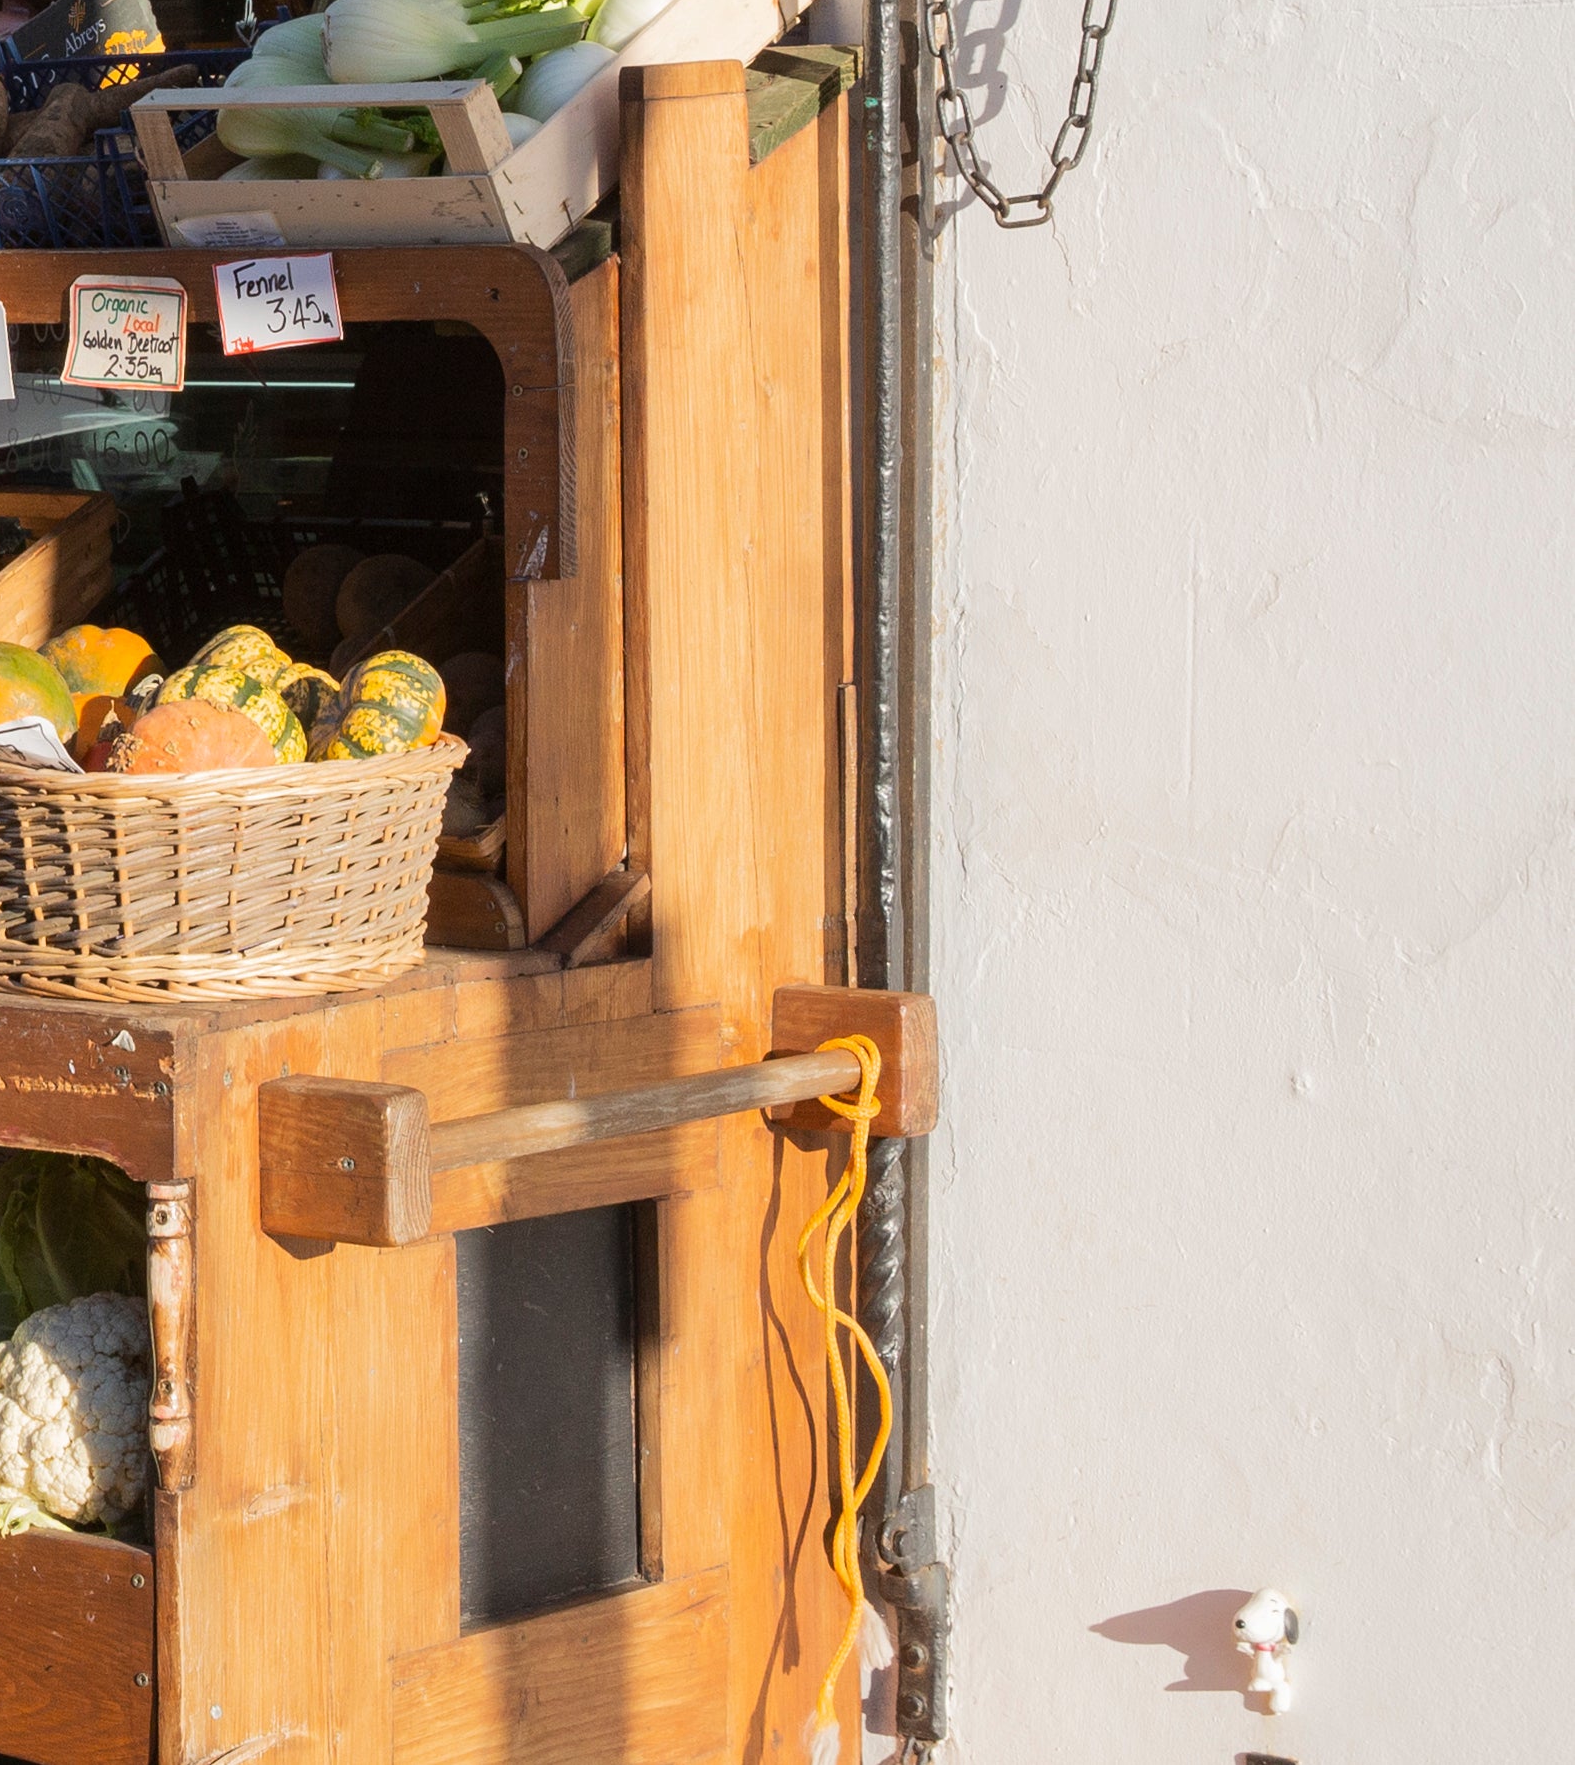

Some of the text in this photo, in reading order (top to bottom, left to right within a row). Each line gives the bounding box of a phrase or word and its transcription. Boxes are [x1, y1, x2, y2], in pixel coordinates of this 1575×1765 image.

[65, 18, 106, 58] Abreys
[233, 262, 294, 299] Fennel
[91, 292, 149, 324] Organic
[122, 314, 161, 334] Local
[83, 332, 179, 356] Golden Beetroot
